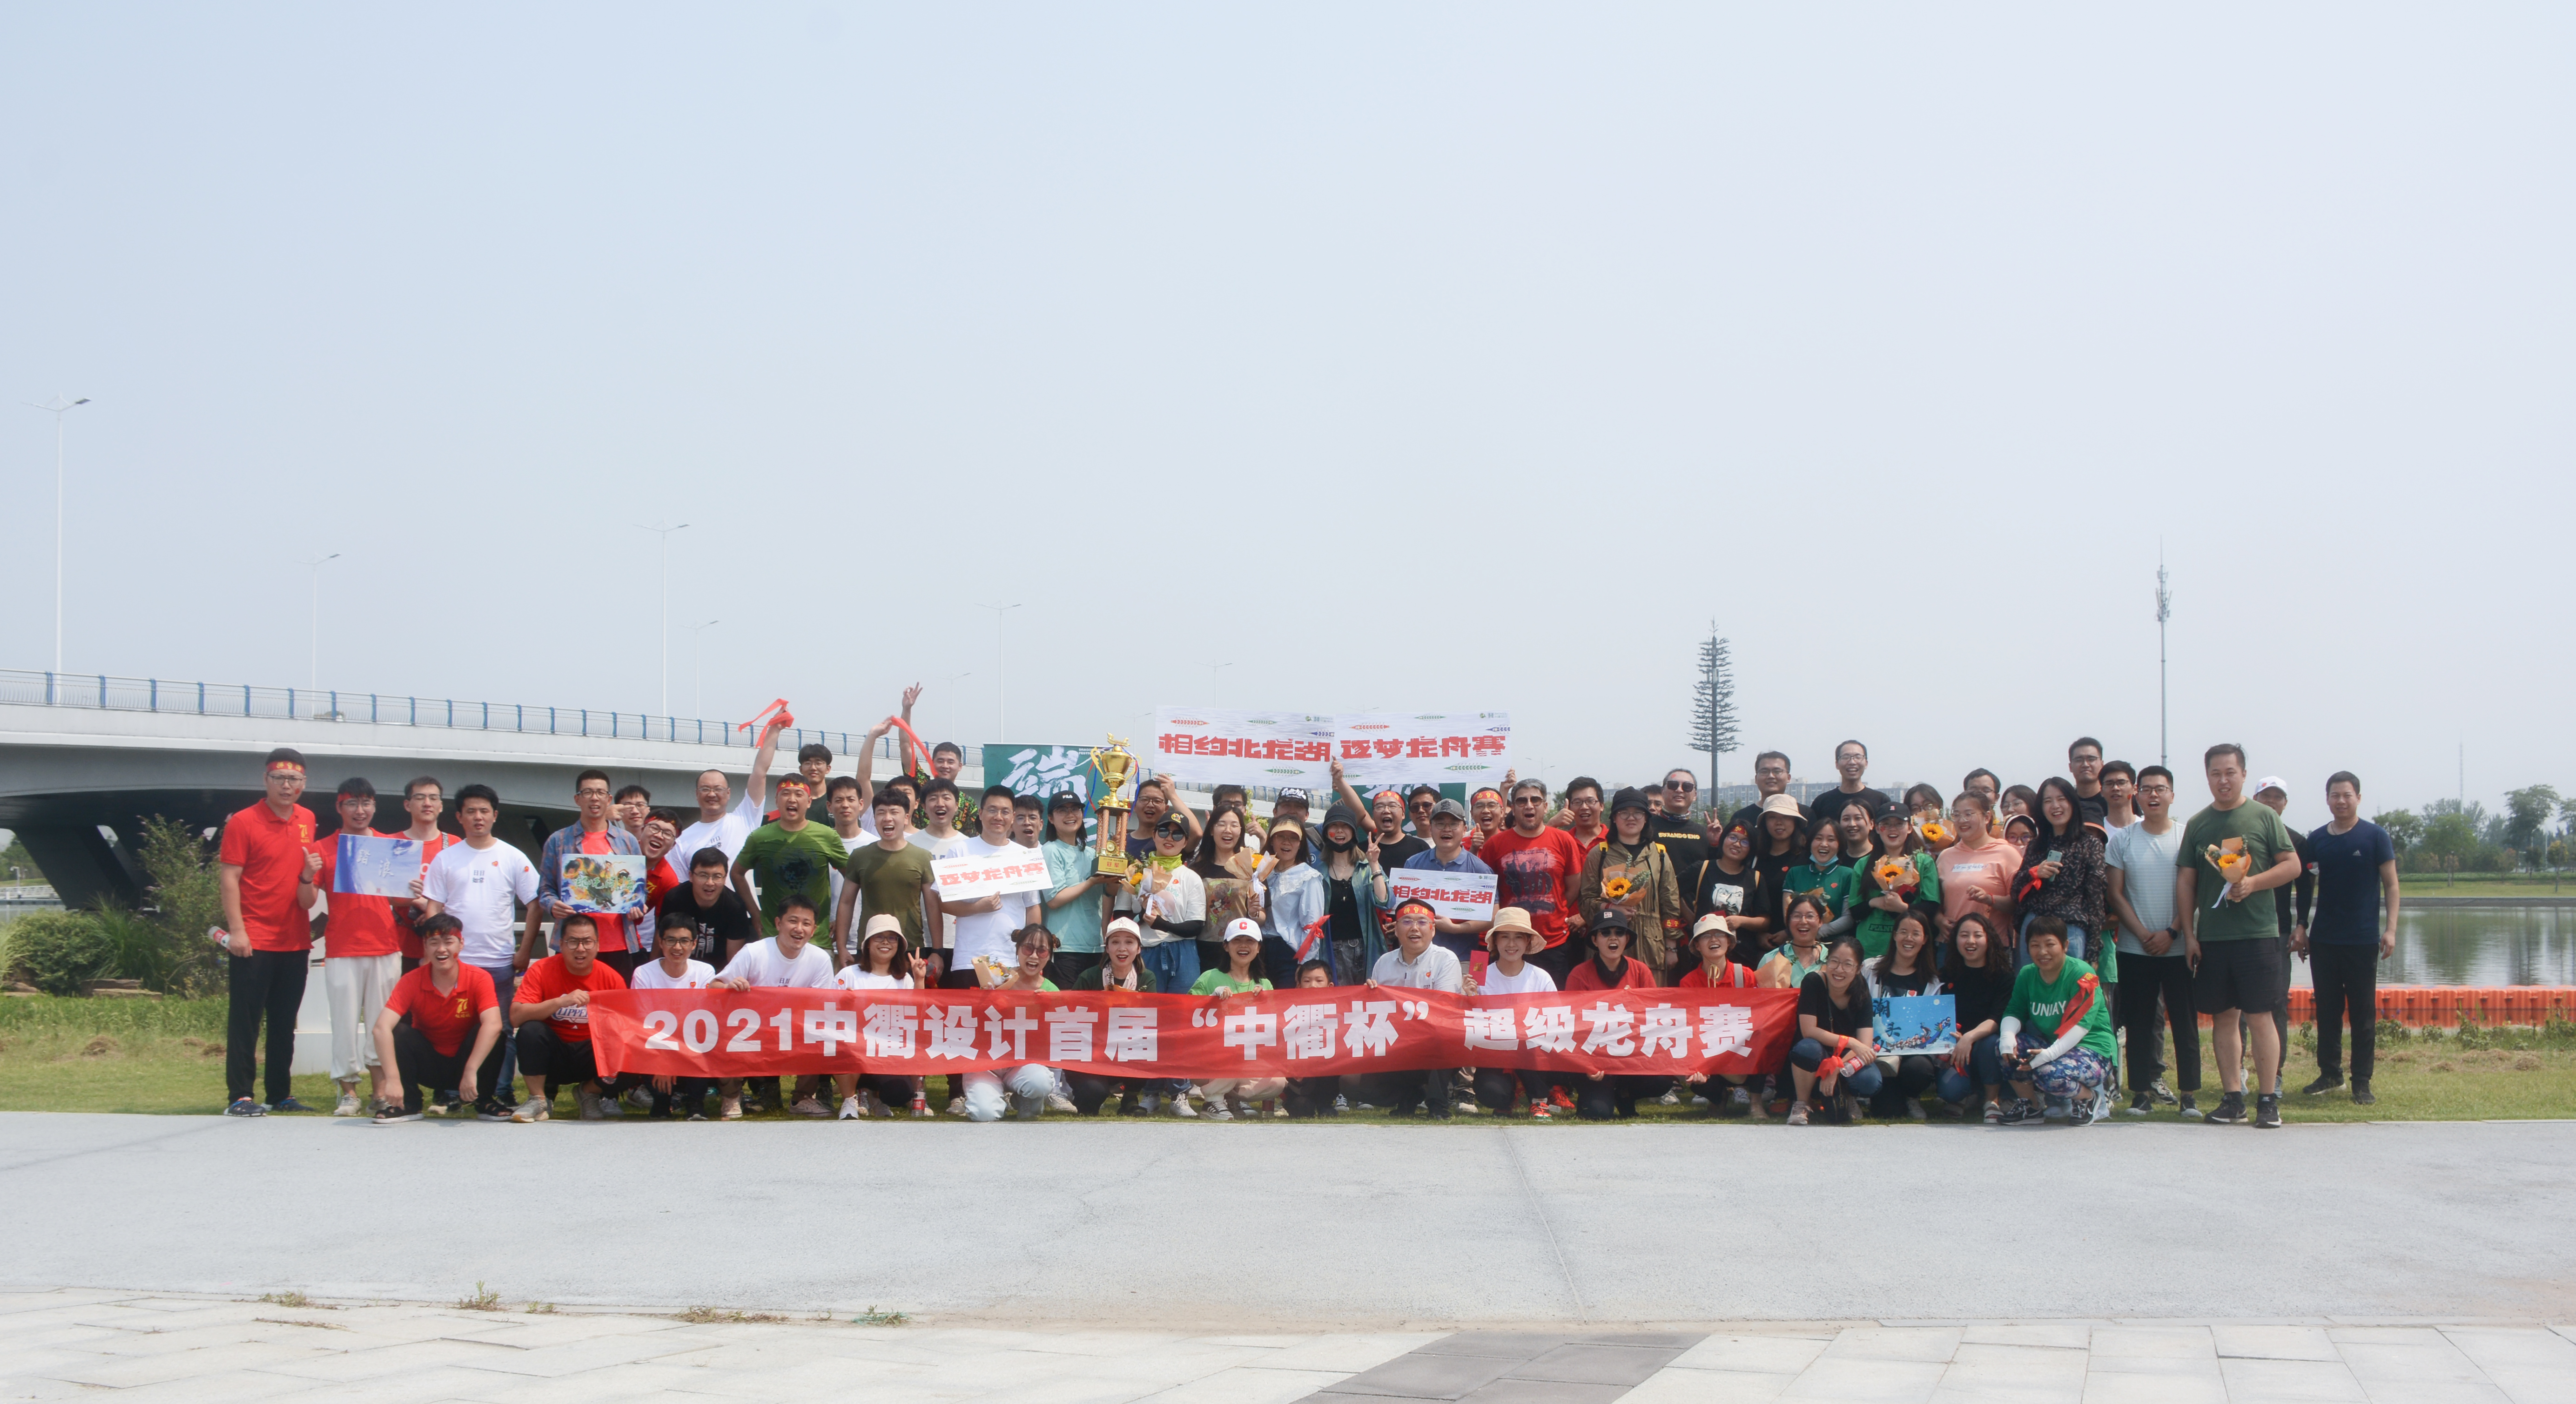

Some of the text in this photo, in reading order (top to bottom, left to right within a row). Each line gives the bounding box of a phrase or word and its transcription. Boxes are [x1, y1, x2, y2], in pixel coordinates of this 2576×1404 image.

[1158, 734, 1331, 762] 相约北龙湖
[1340, 736, 1506, 759] 逐梦龙舟赛
[939, 863, 1044, 886] 逐梦龙舟赛
[1392, 885, 1493, 904] 相约北龙湖
